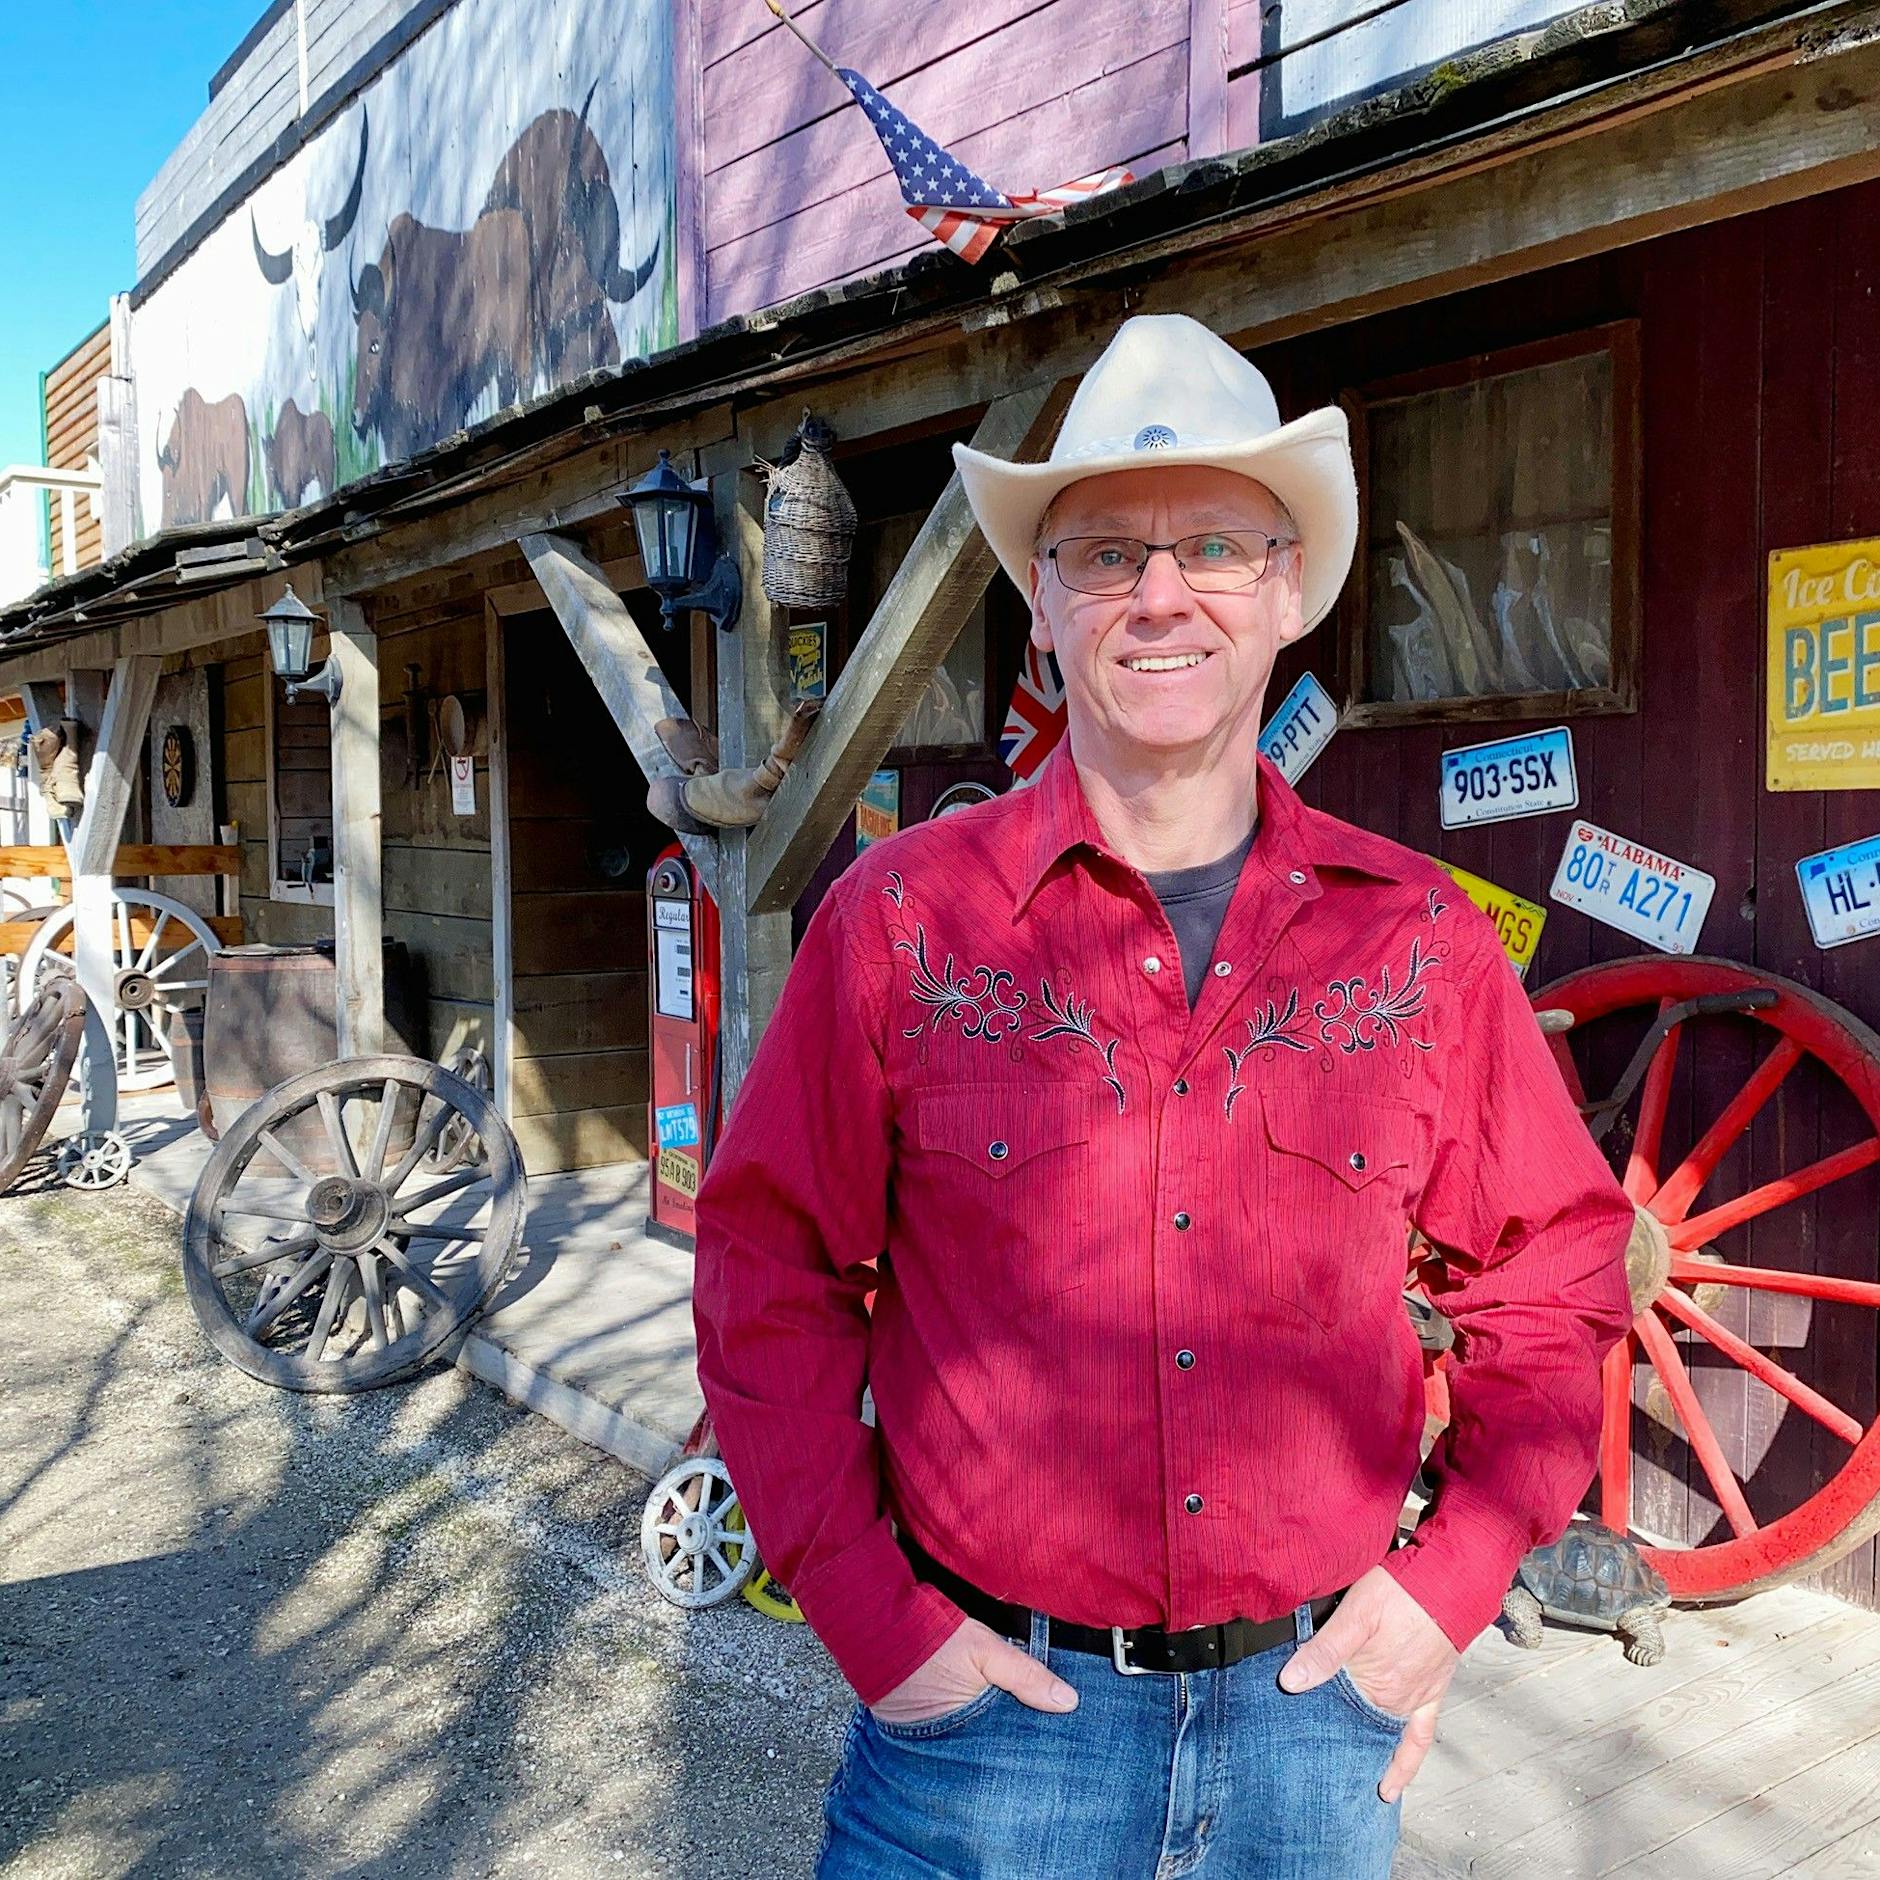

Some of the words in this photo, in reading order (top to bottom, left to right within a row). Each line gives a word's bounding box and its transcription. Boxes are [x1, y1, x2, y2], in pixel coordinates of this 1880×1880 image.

[1783, 567, 1834, 609] Ice
[1785, 609, 1880, 723] BEE
[1474, 743, 1535, 763] Connecticut
[1785, 741, 1856, 762] SERVED
[1475, 803, 1523, 817] Constitution
[1525, 799, 1544, 808] State
[1600, 834, 1680, 881] ALABAMA
[1555, 888, 1575, 903] NOV
[1566, 844, 1604, 890] 80
[1618, 868, 1693, 932] A271
[658, 906, 690, 925] Regular
